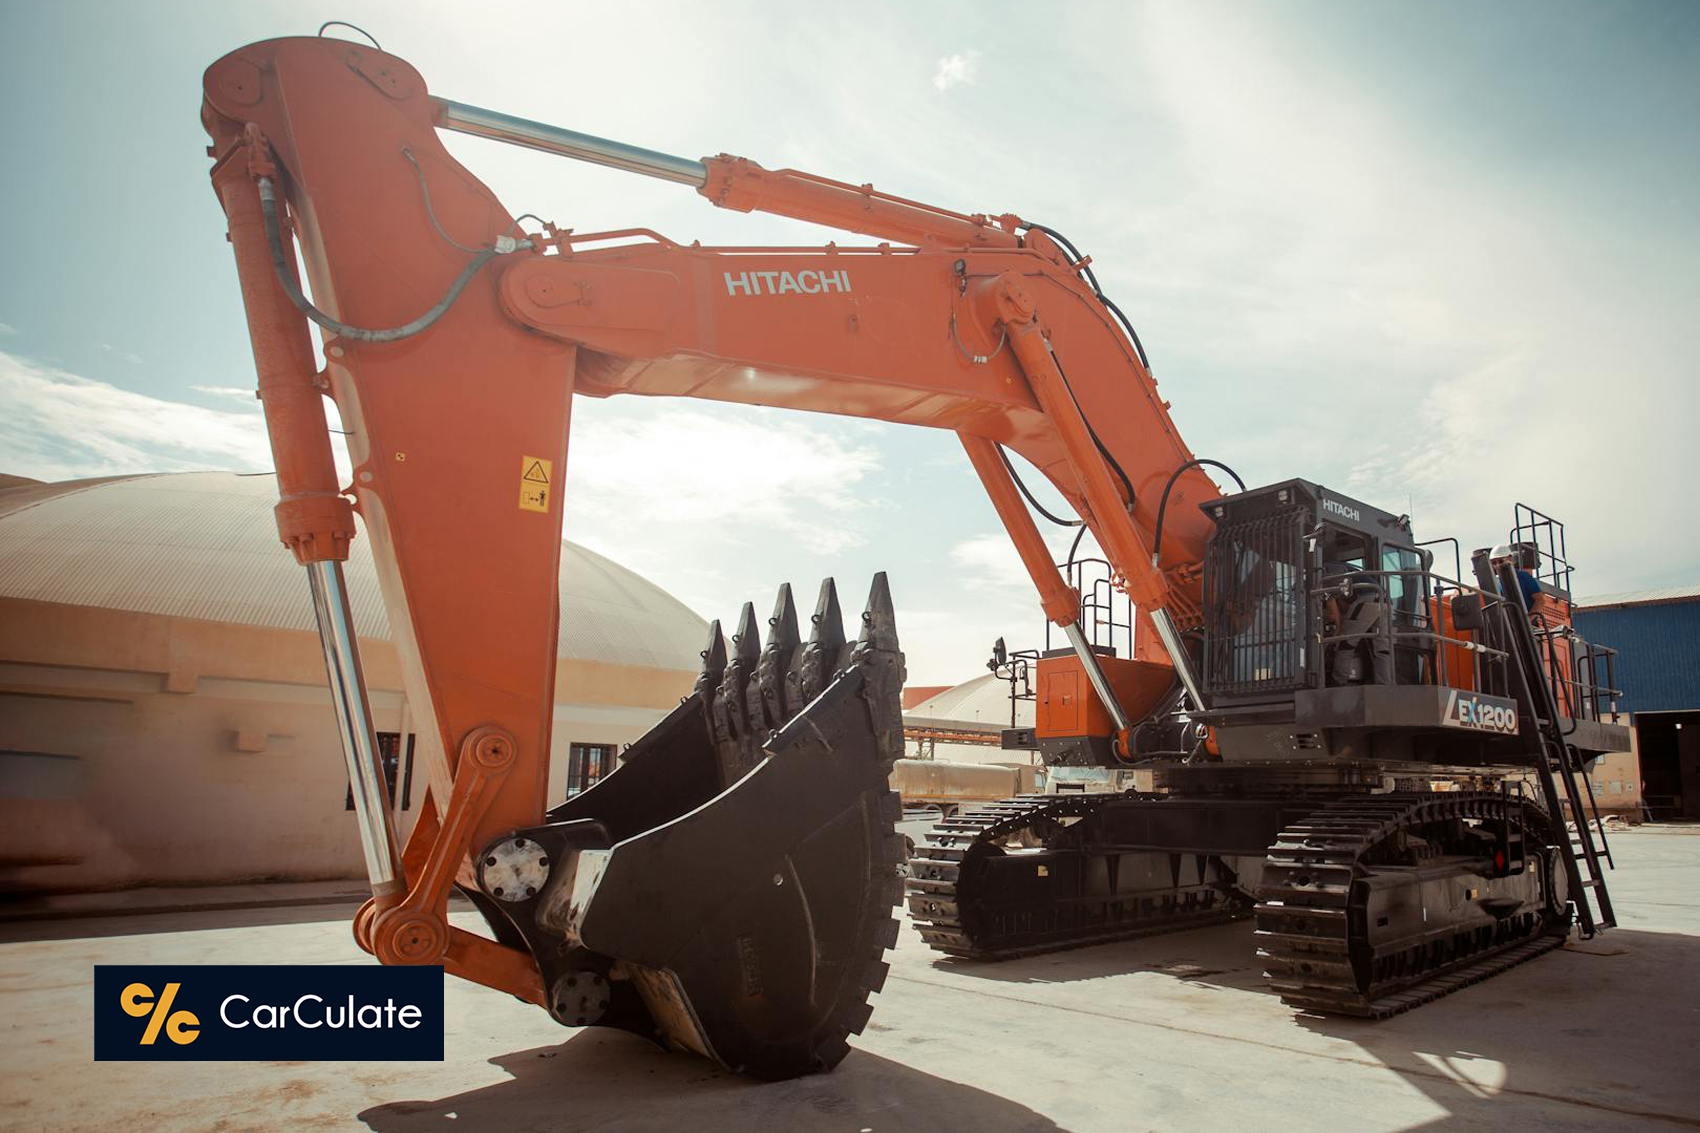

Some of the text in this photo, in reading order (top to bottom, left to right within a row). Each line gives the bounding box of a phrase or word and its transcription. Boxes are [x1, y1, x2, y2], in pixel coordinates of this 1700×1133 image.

[723, 270, 852, 296] HITACHI
[1322, 498, 1360, 522] HITACHI
[1457, 696, 1516, 731] EX1200
